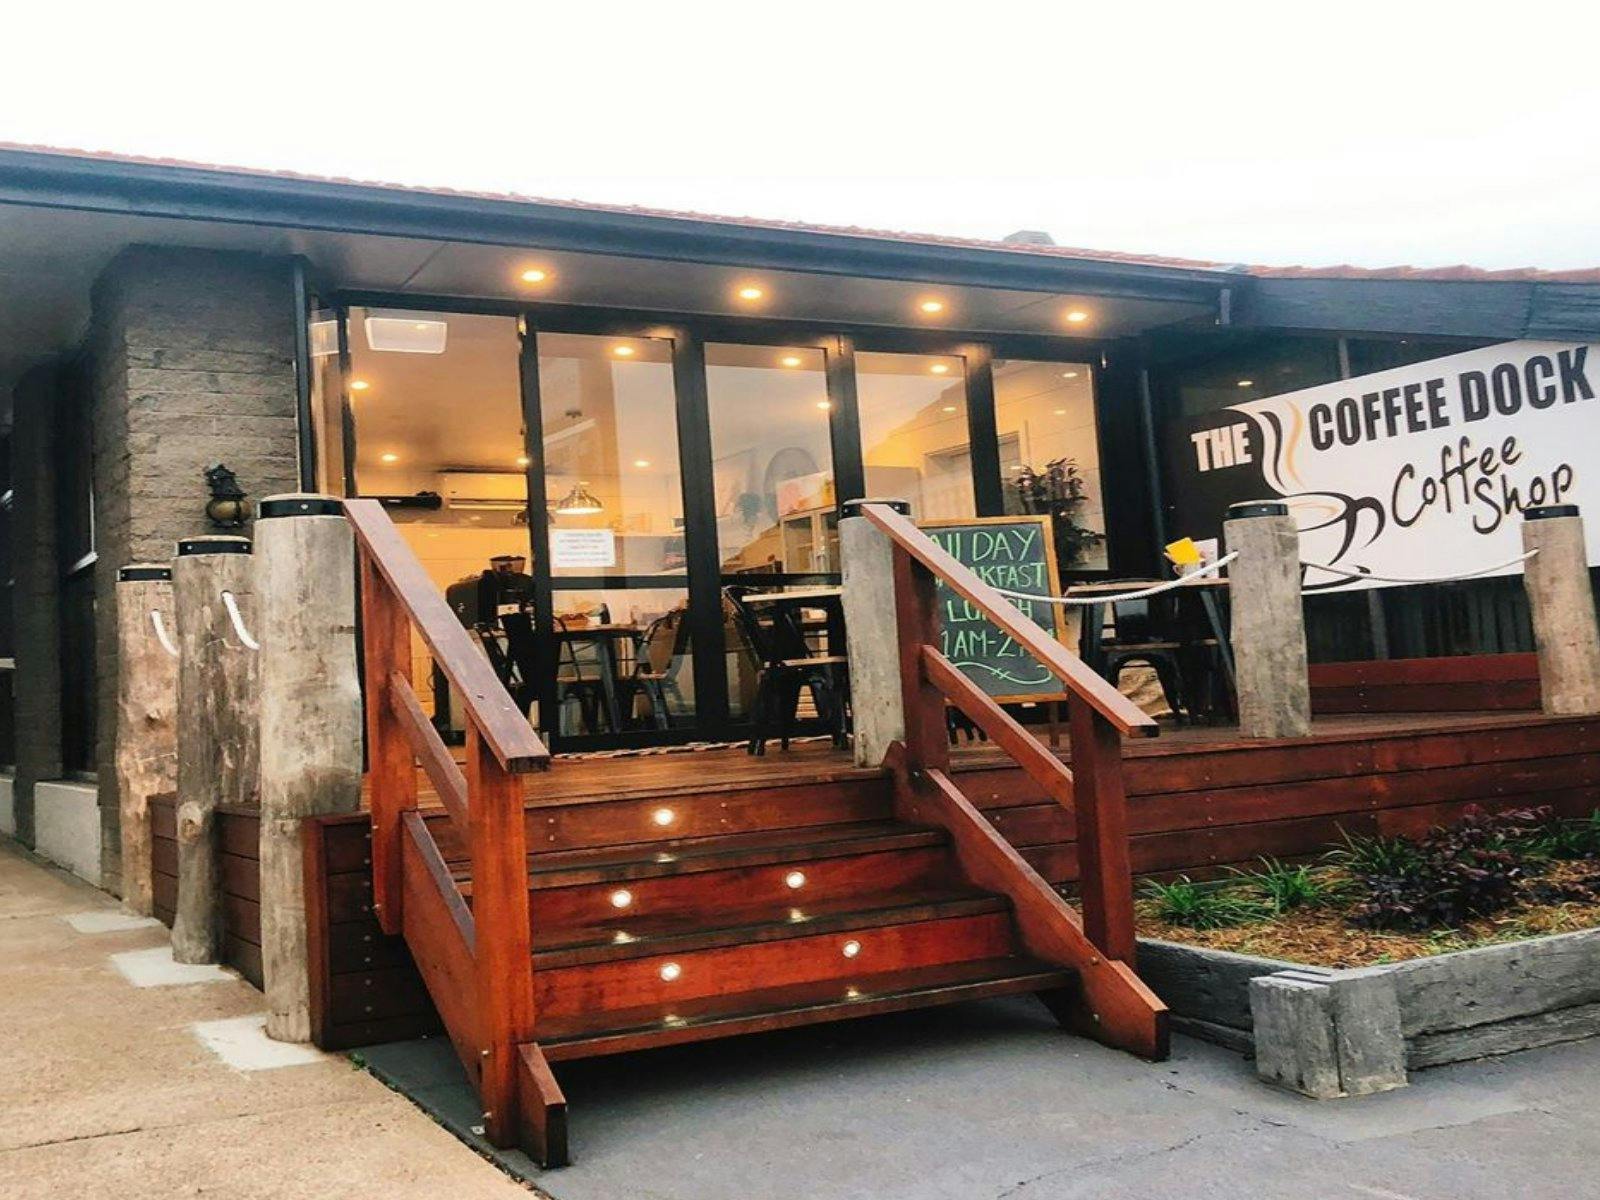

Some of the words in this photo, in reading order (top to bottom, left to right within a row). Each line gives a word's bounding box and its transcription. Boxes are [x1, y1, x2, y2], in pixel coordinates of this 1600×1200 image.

[1191, 422, 1253, 472] THE
[1308, 377, 1452, 452] COFFEE
[1457, 345, 1597, 423] DOCK
[1391, 435, 1524, 529] Coffee
[1472, 463, 1574, 535] Shop
[972, 529, 1036, 561] DAY
[946, 598, 1033, 622] LUH
